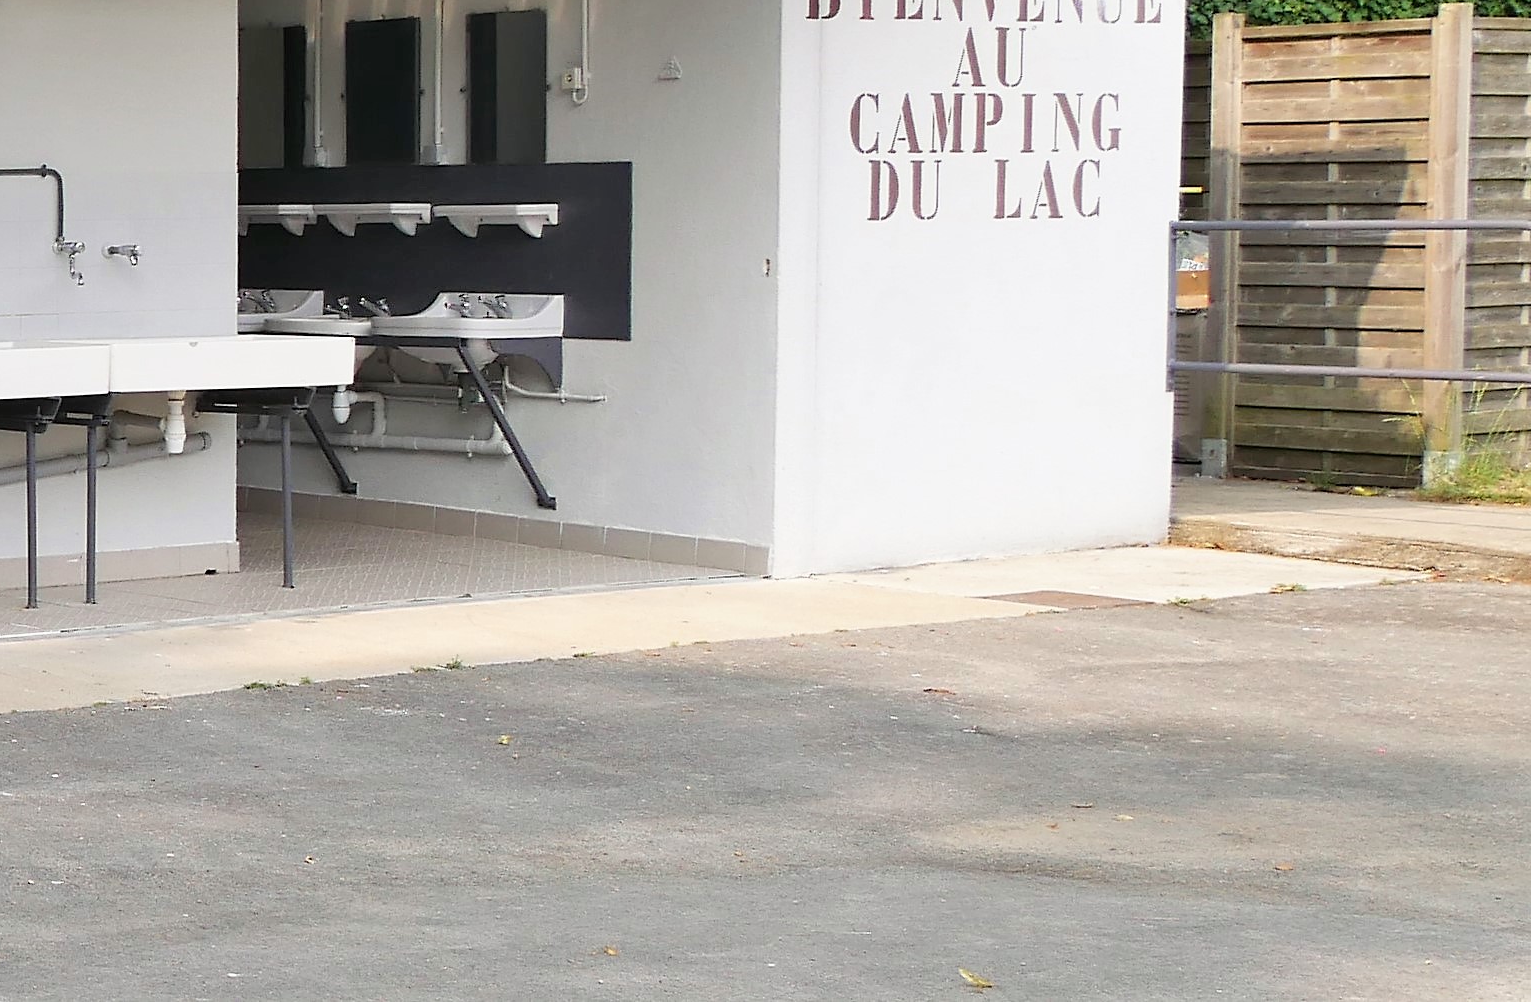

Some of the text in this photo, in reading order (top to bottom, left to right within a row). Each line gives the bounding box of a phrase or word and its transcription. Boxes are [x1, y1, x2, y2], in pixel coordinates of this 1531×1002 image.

[951, 26, 1026, 88] AU
[849, 92, 1122, 154] CAMPING
[866, 159, 1101, 221] DU LAC
